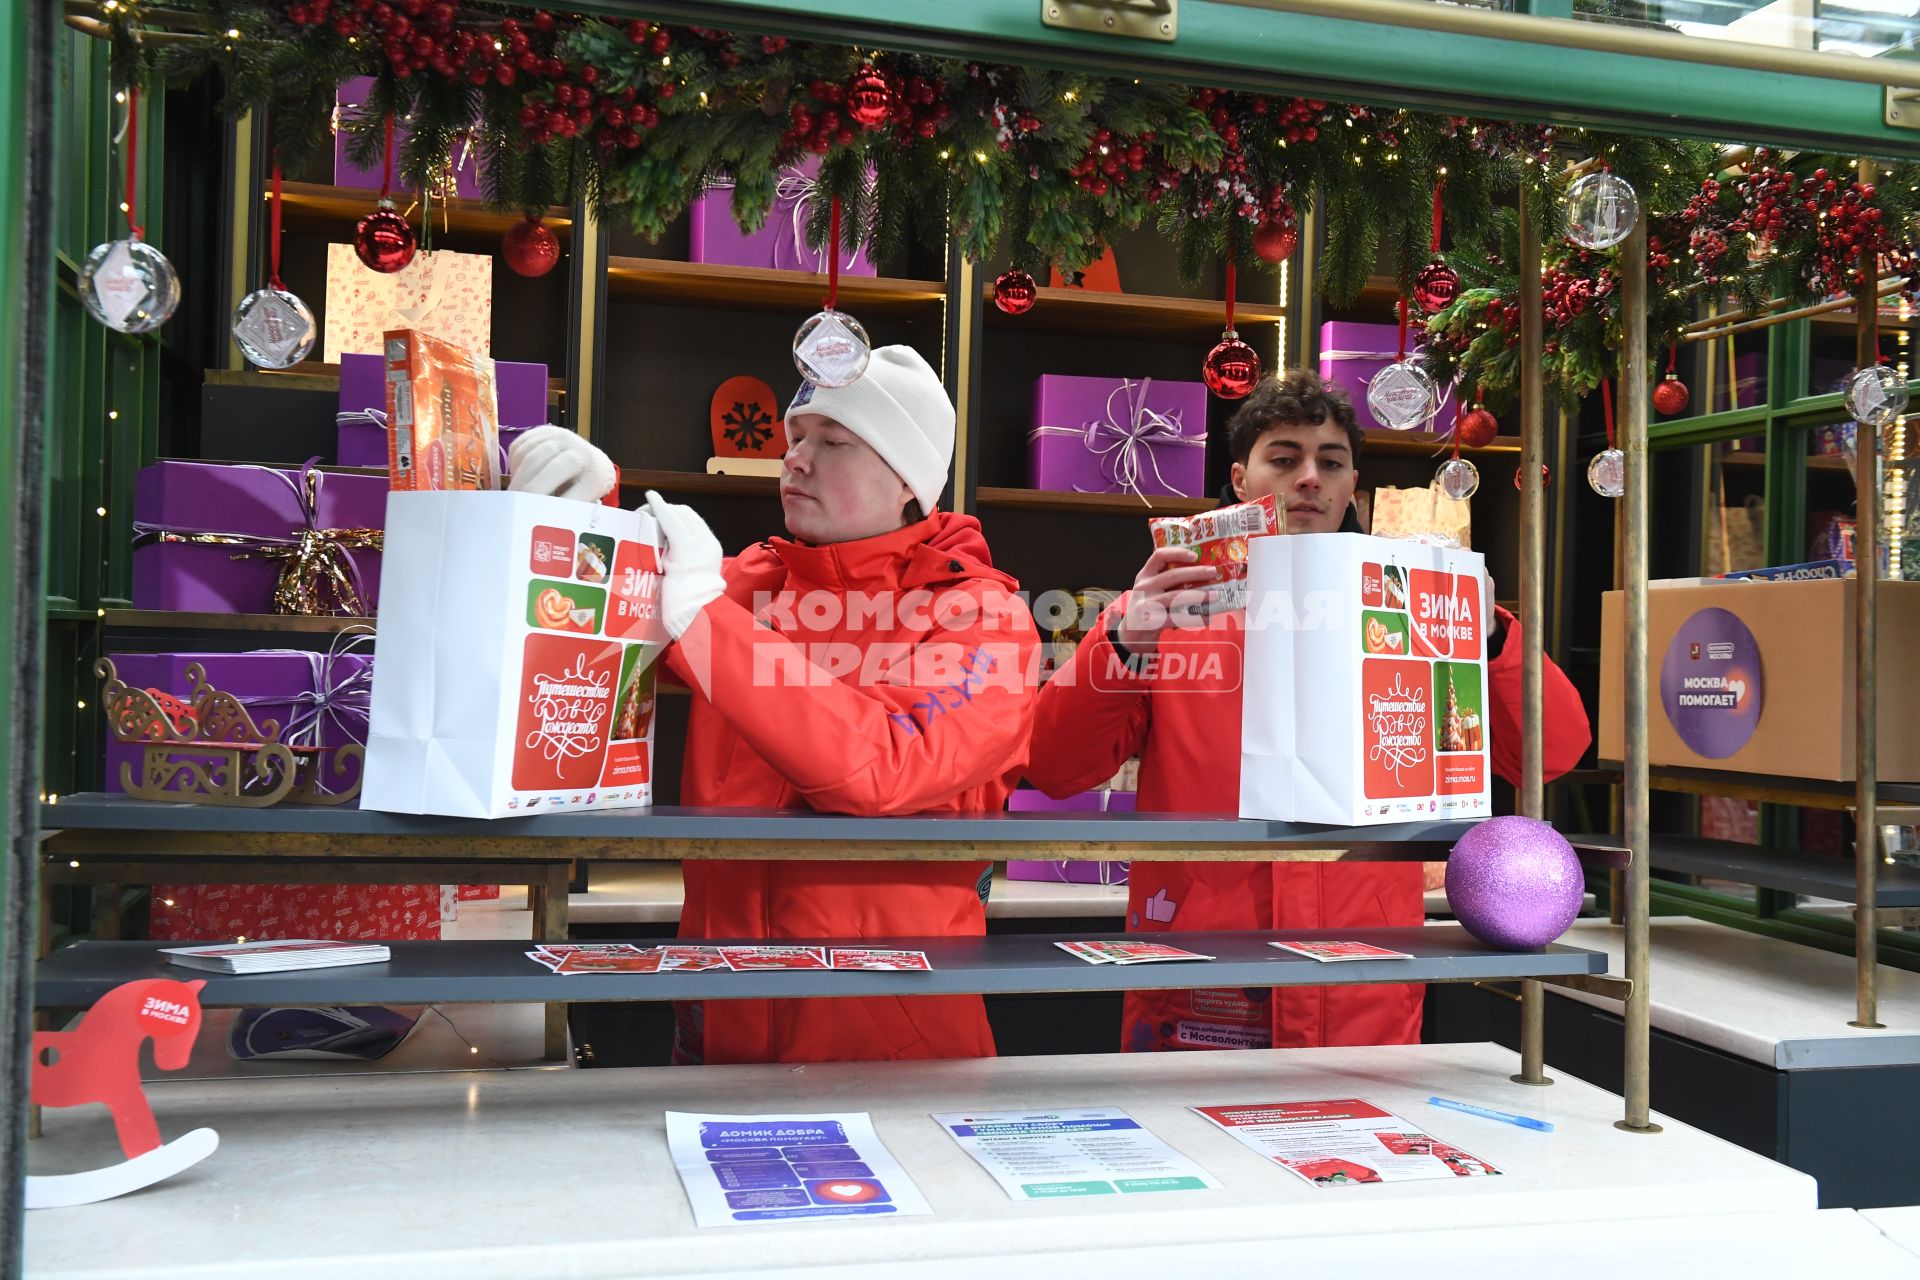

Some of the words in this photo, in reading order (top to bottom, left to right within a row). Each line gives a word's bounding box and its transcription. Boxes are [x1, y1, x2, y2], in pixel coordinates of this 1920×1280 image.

[620, 566, 659, 600] ЗИМ
[618, 600, 627, 616] В
[1419, 592, 1473, 623] ЗИМА
[1684, 677, 1729, 689] МОСКВА
[1679, 694, 1736, 707] ПОМОГАЕТ
[143, 996, 190, 1018] ЗИМА
[775, 1128, 825, 1136] ДОБРА
